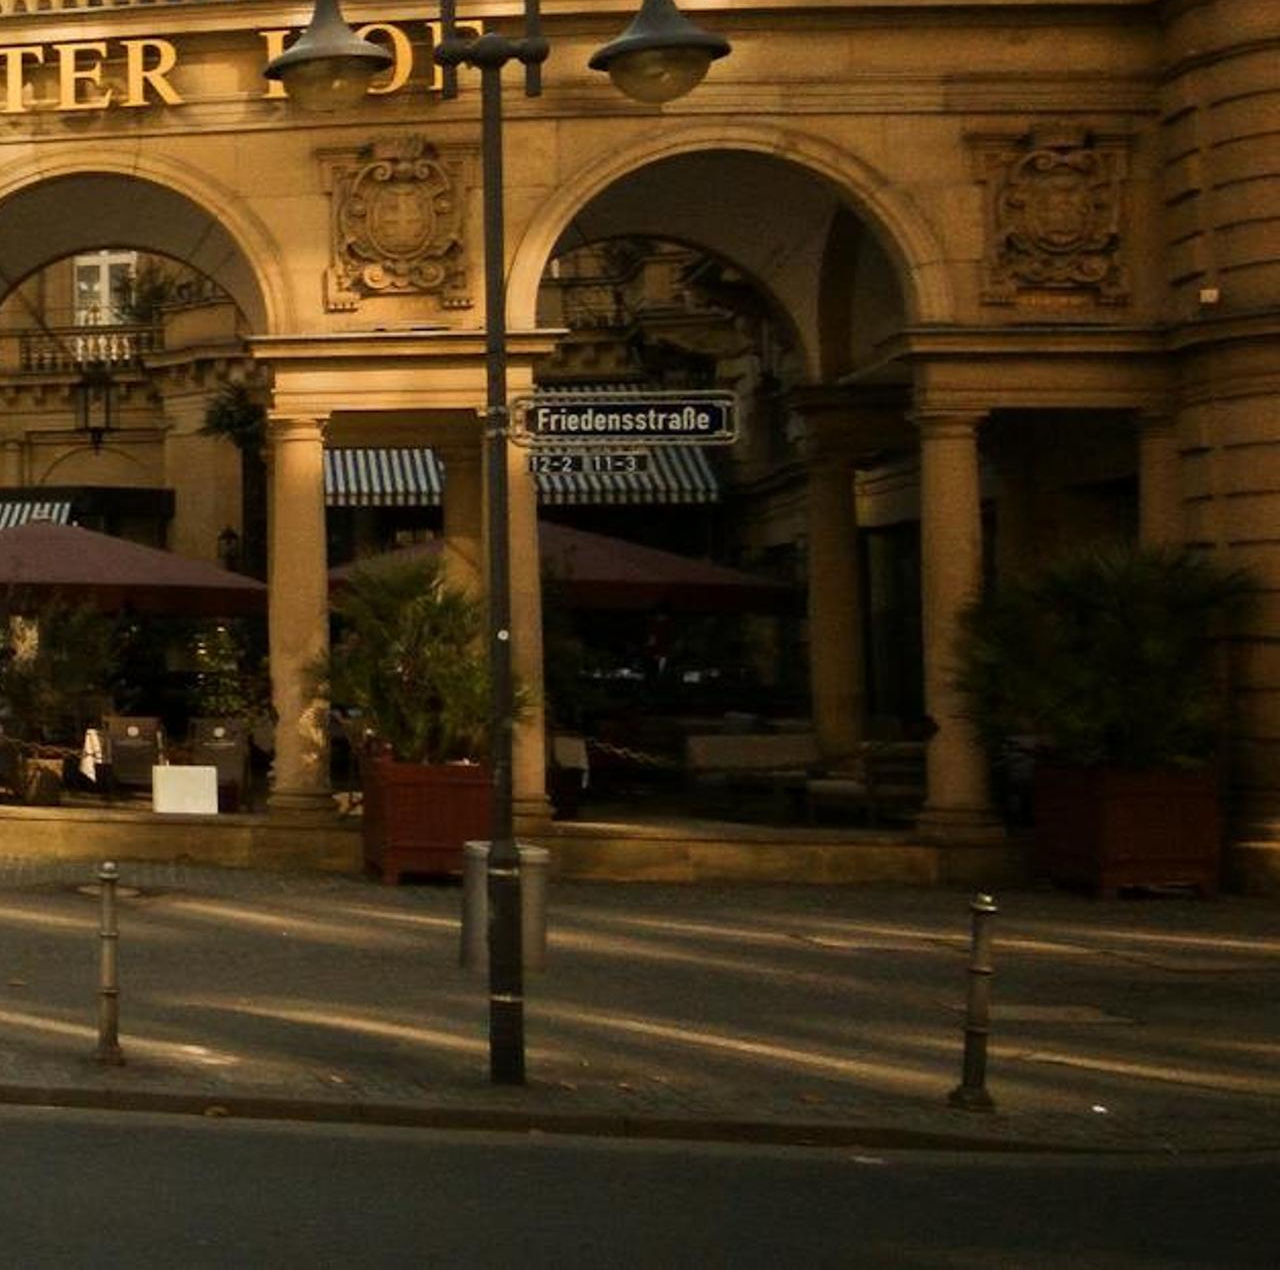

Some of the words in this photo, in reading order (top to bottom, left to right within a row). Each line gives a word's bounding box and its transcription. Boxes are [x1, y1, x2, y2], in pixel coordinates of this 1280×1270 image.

[537, 406, 710, 431] Friedensstraße
[532, 456, 572, 472] 12-2
[594, 455, 636, 471] 11-3
